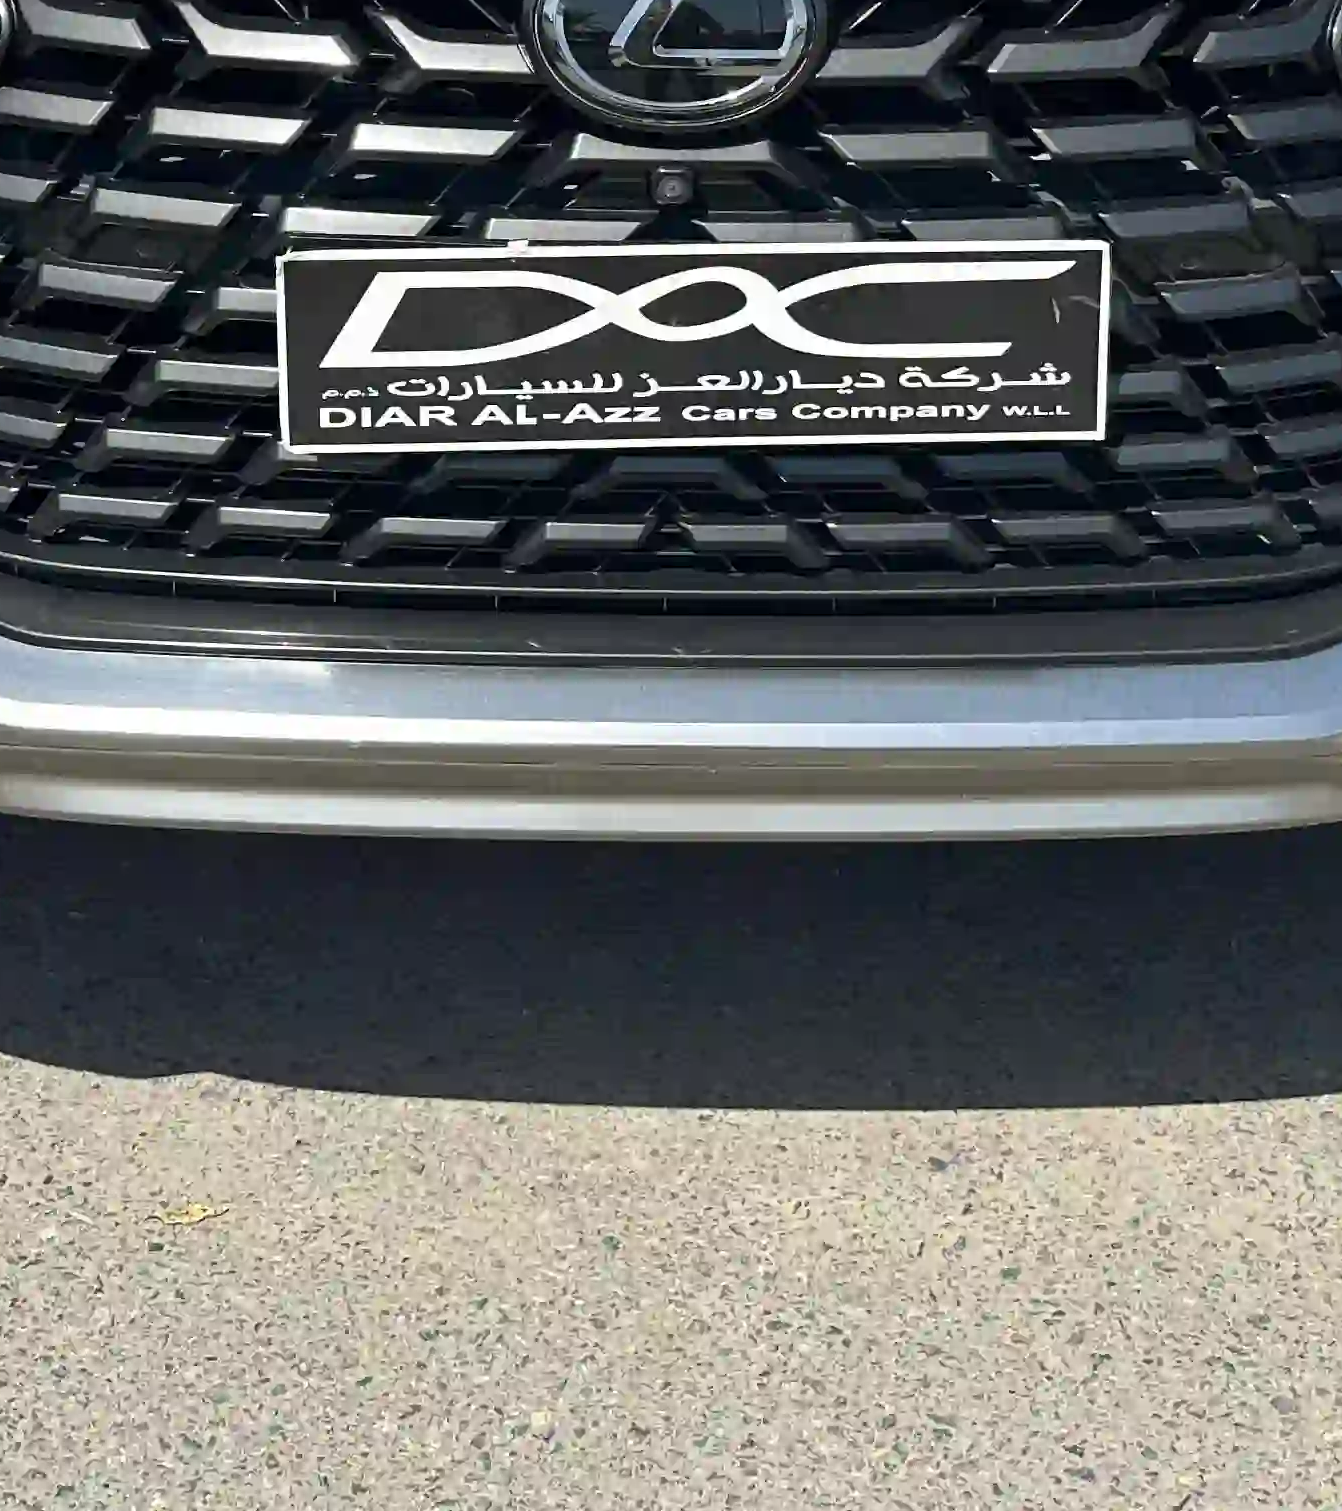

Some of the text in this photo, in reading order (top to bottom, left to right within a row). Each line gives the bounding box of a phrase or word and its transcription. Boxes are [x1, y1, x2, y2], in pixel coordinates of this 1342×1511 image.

[385, 371, 624, 402] للسيارات
[898, 361, 1072, 392] شركة
[318, 404, 458, 429] DIAR
[681, 404, 778, 422] Cars
[790, 402, 992, 422] Company
